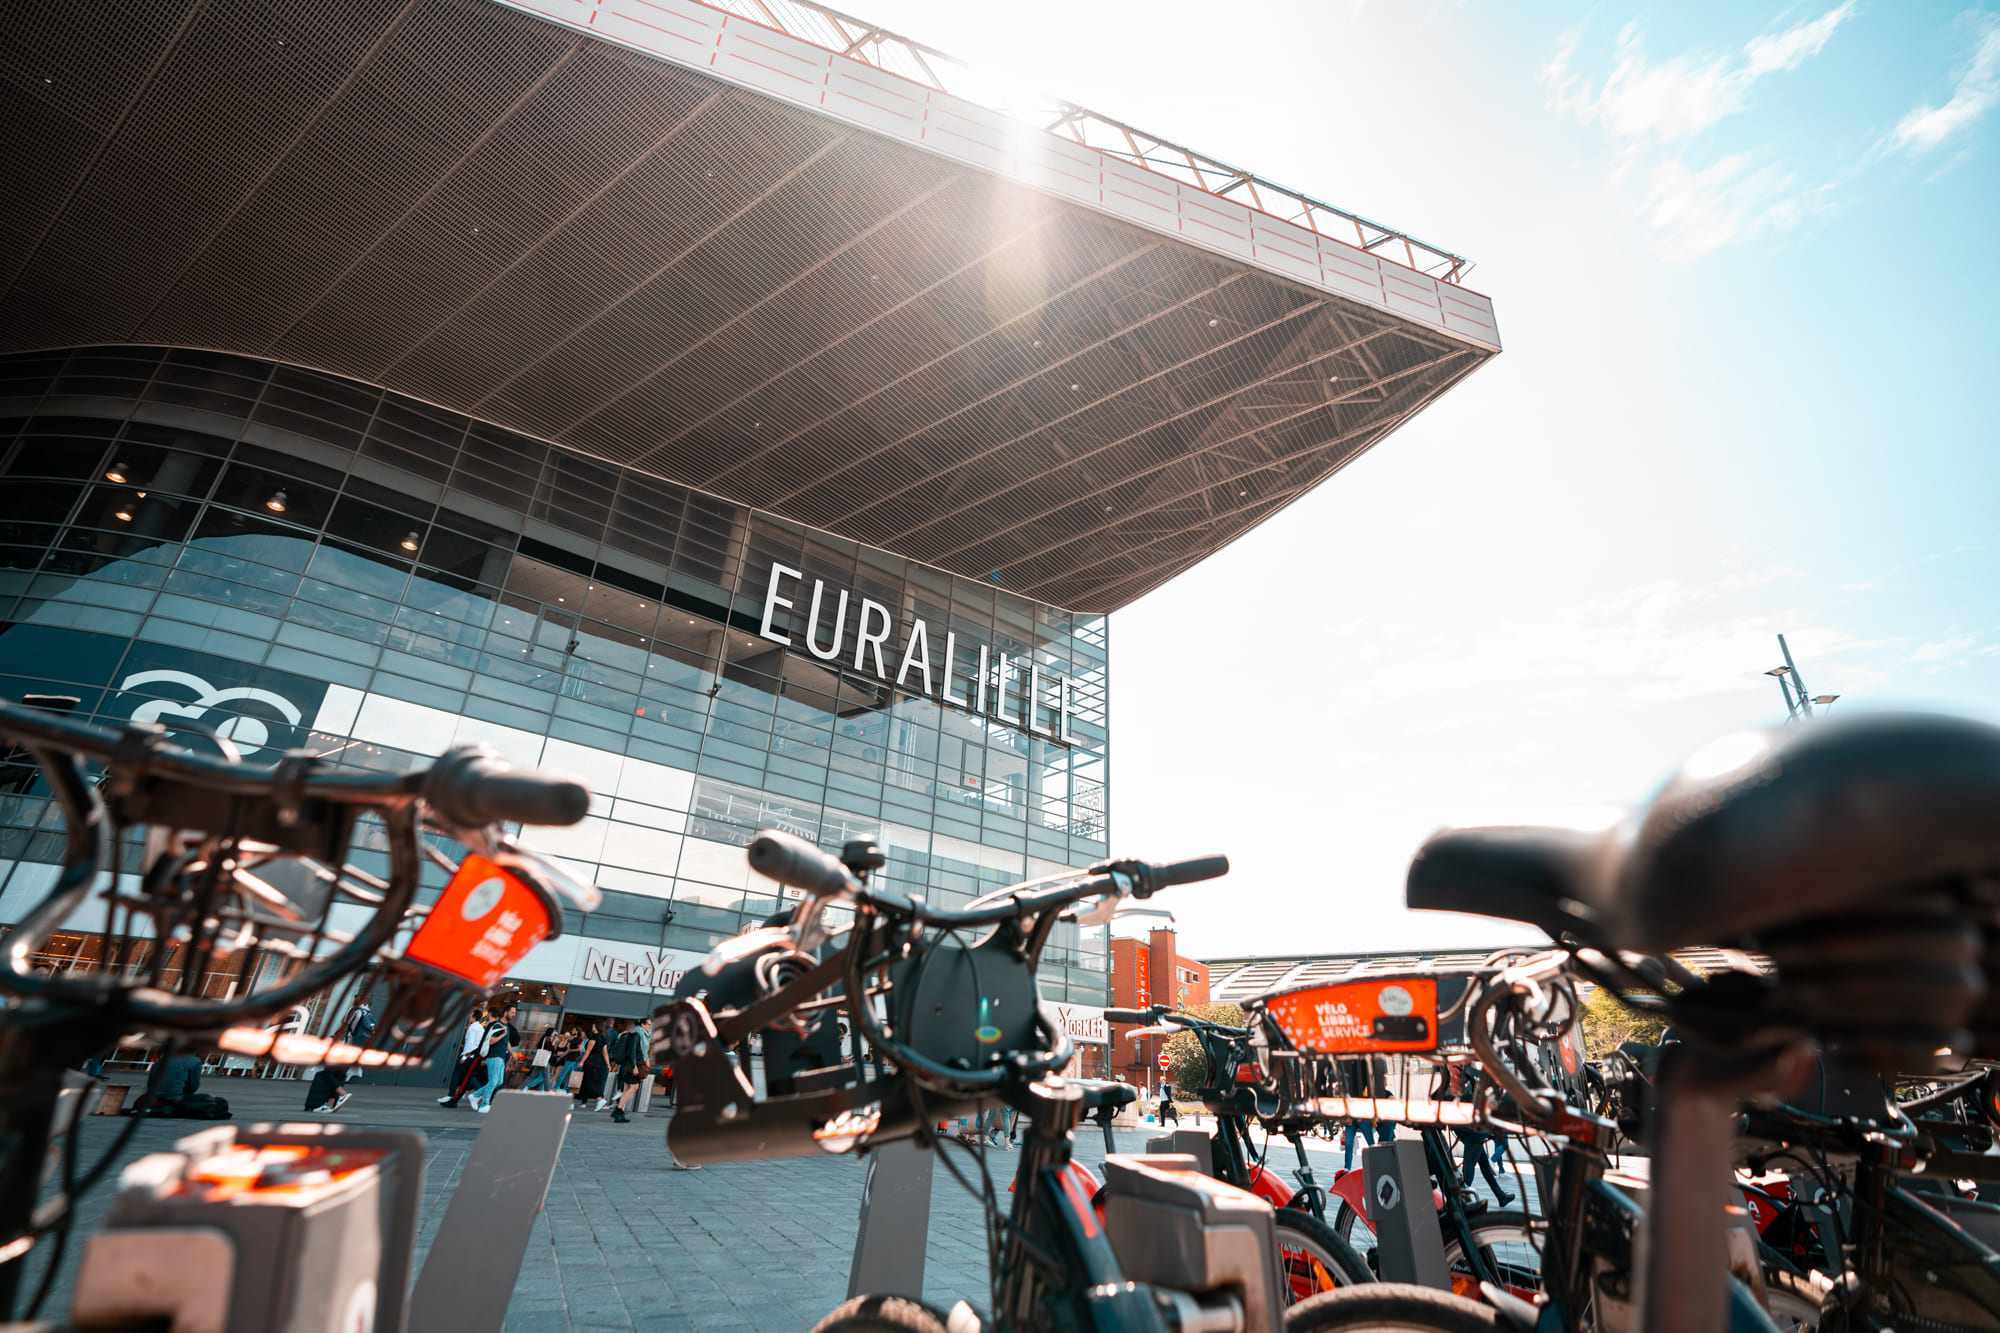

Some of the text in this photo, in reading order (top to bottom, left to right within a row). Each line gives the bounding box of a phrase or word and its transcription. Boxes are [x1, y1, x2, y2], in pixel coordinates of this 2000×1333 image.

[760, 562, 1082, 746] EURALILLE
[1315, 1001, 1347, 1015] VÉLO
[1058, 1007, 1104, 1038] YORKER
[1322, 1025, 1370, 1037] SERVICE
